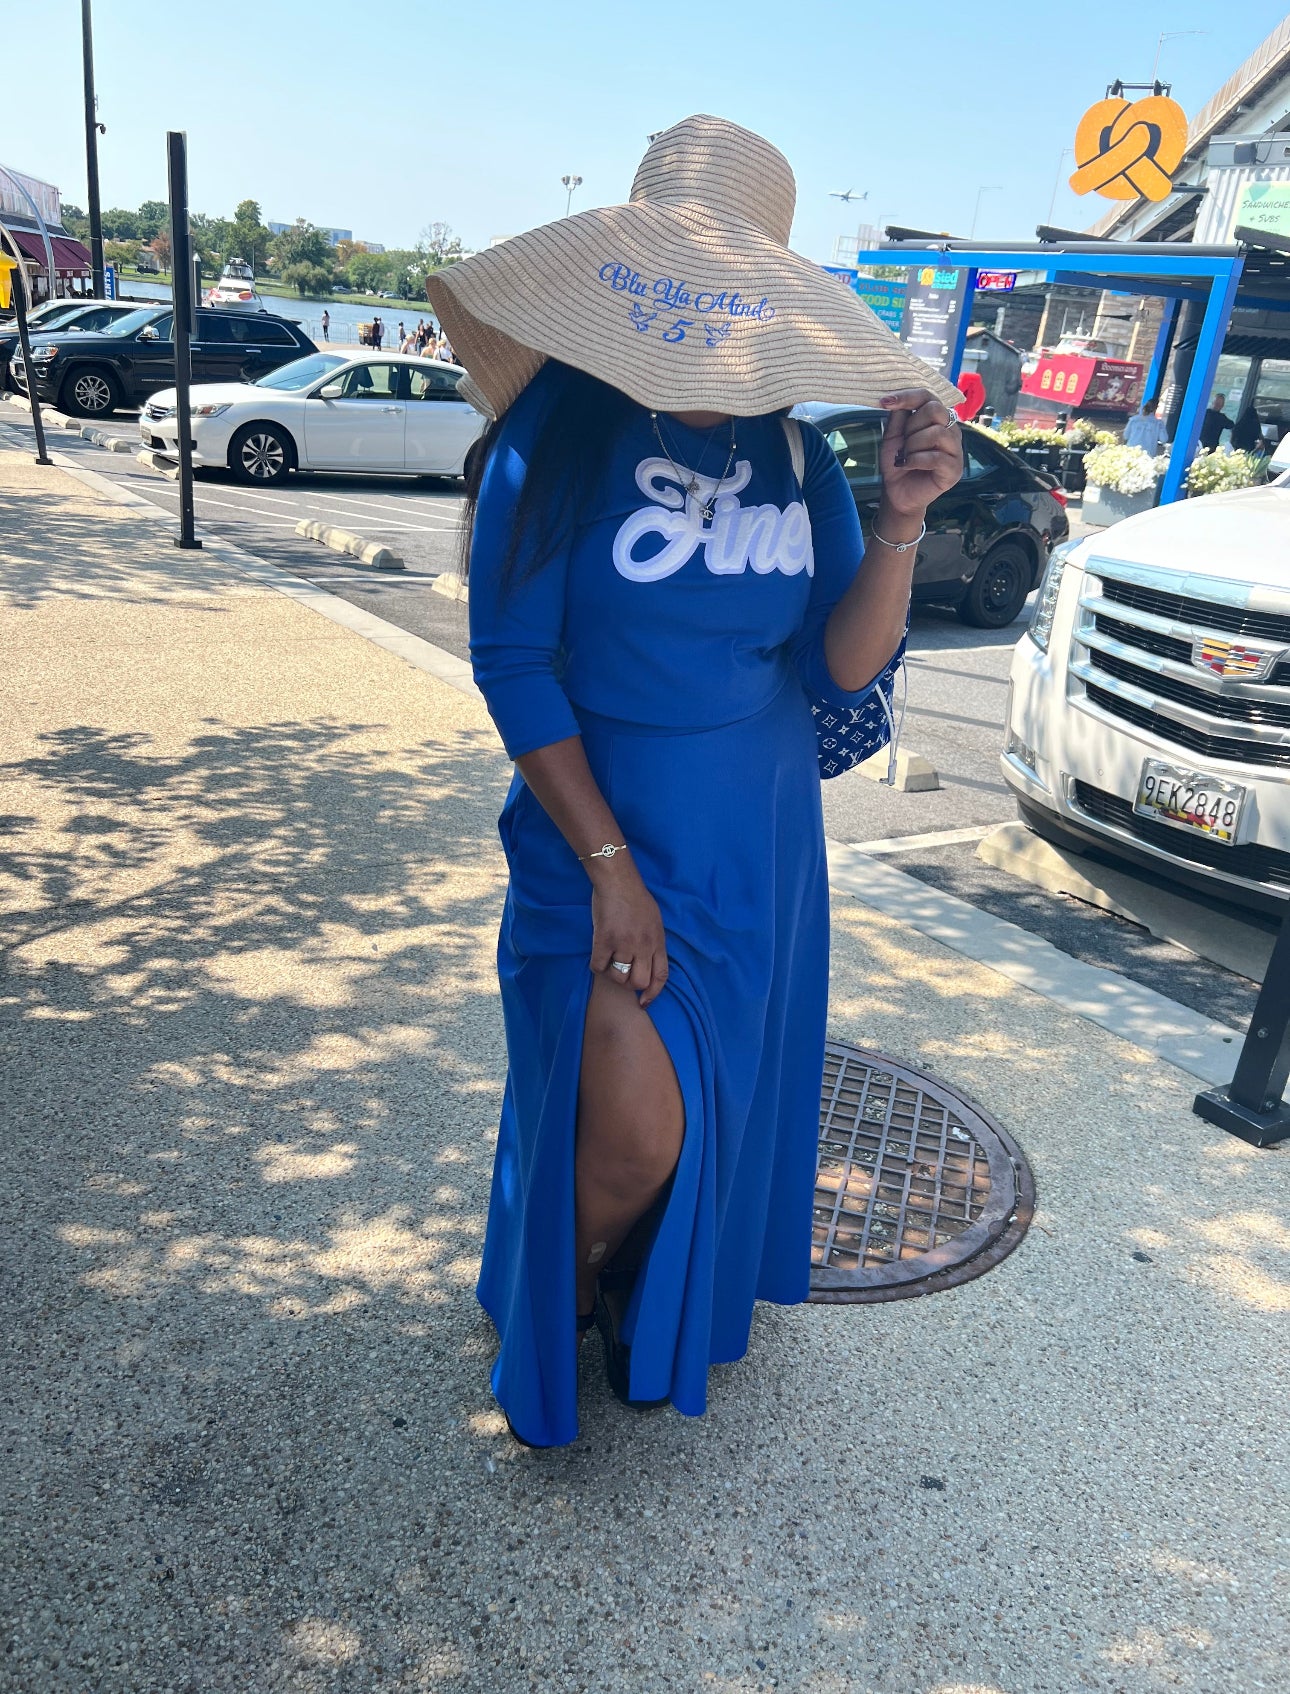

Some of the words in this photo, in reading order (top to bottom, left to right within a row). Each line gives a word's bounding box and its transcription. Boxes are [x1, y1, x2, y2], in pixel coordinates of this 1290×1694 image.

[1258, 214, 1281, 223] SUBS
[599, 262, 647, 296] Blu
[653, 278, 692, 311] Ya
[694, 291, 776, 321] Mind
[978, 273, 1012, 288] OPEN
[662, 319, 694, 343] 5
[1144, 775, 1237, 827] 9EK2848
